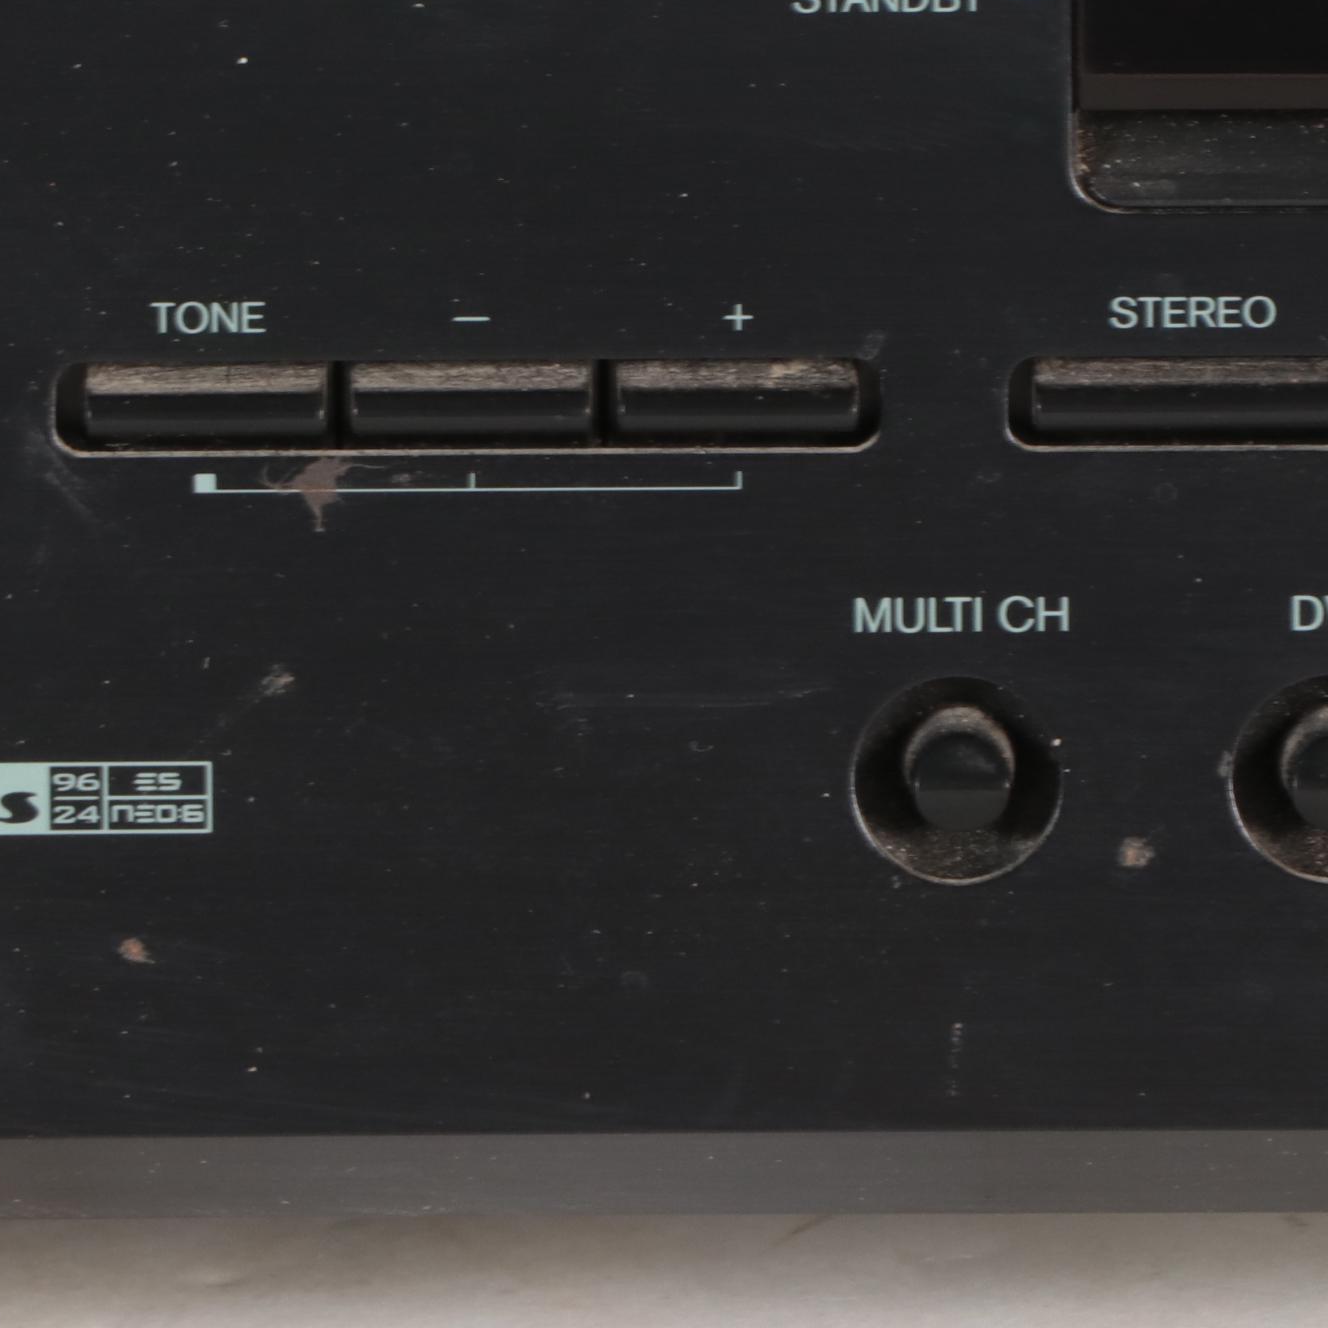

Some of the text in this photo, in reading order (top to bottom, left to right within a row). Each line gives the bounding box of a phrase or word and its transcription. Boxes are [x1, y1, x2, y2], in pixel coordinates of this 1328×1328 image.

[150, 301, 267, 334] TONE
[1109, 295, 1277, 329] STEREO
[855, 595, 1071, 634] MULTI CH
[52, 771, 102, 793] 96
[52, 804, 102, 825] 24
